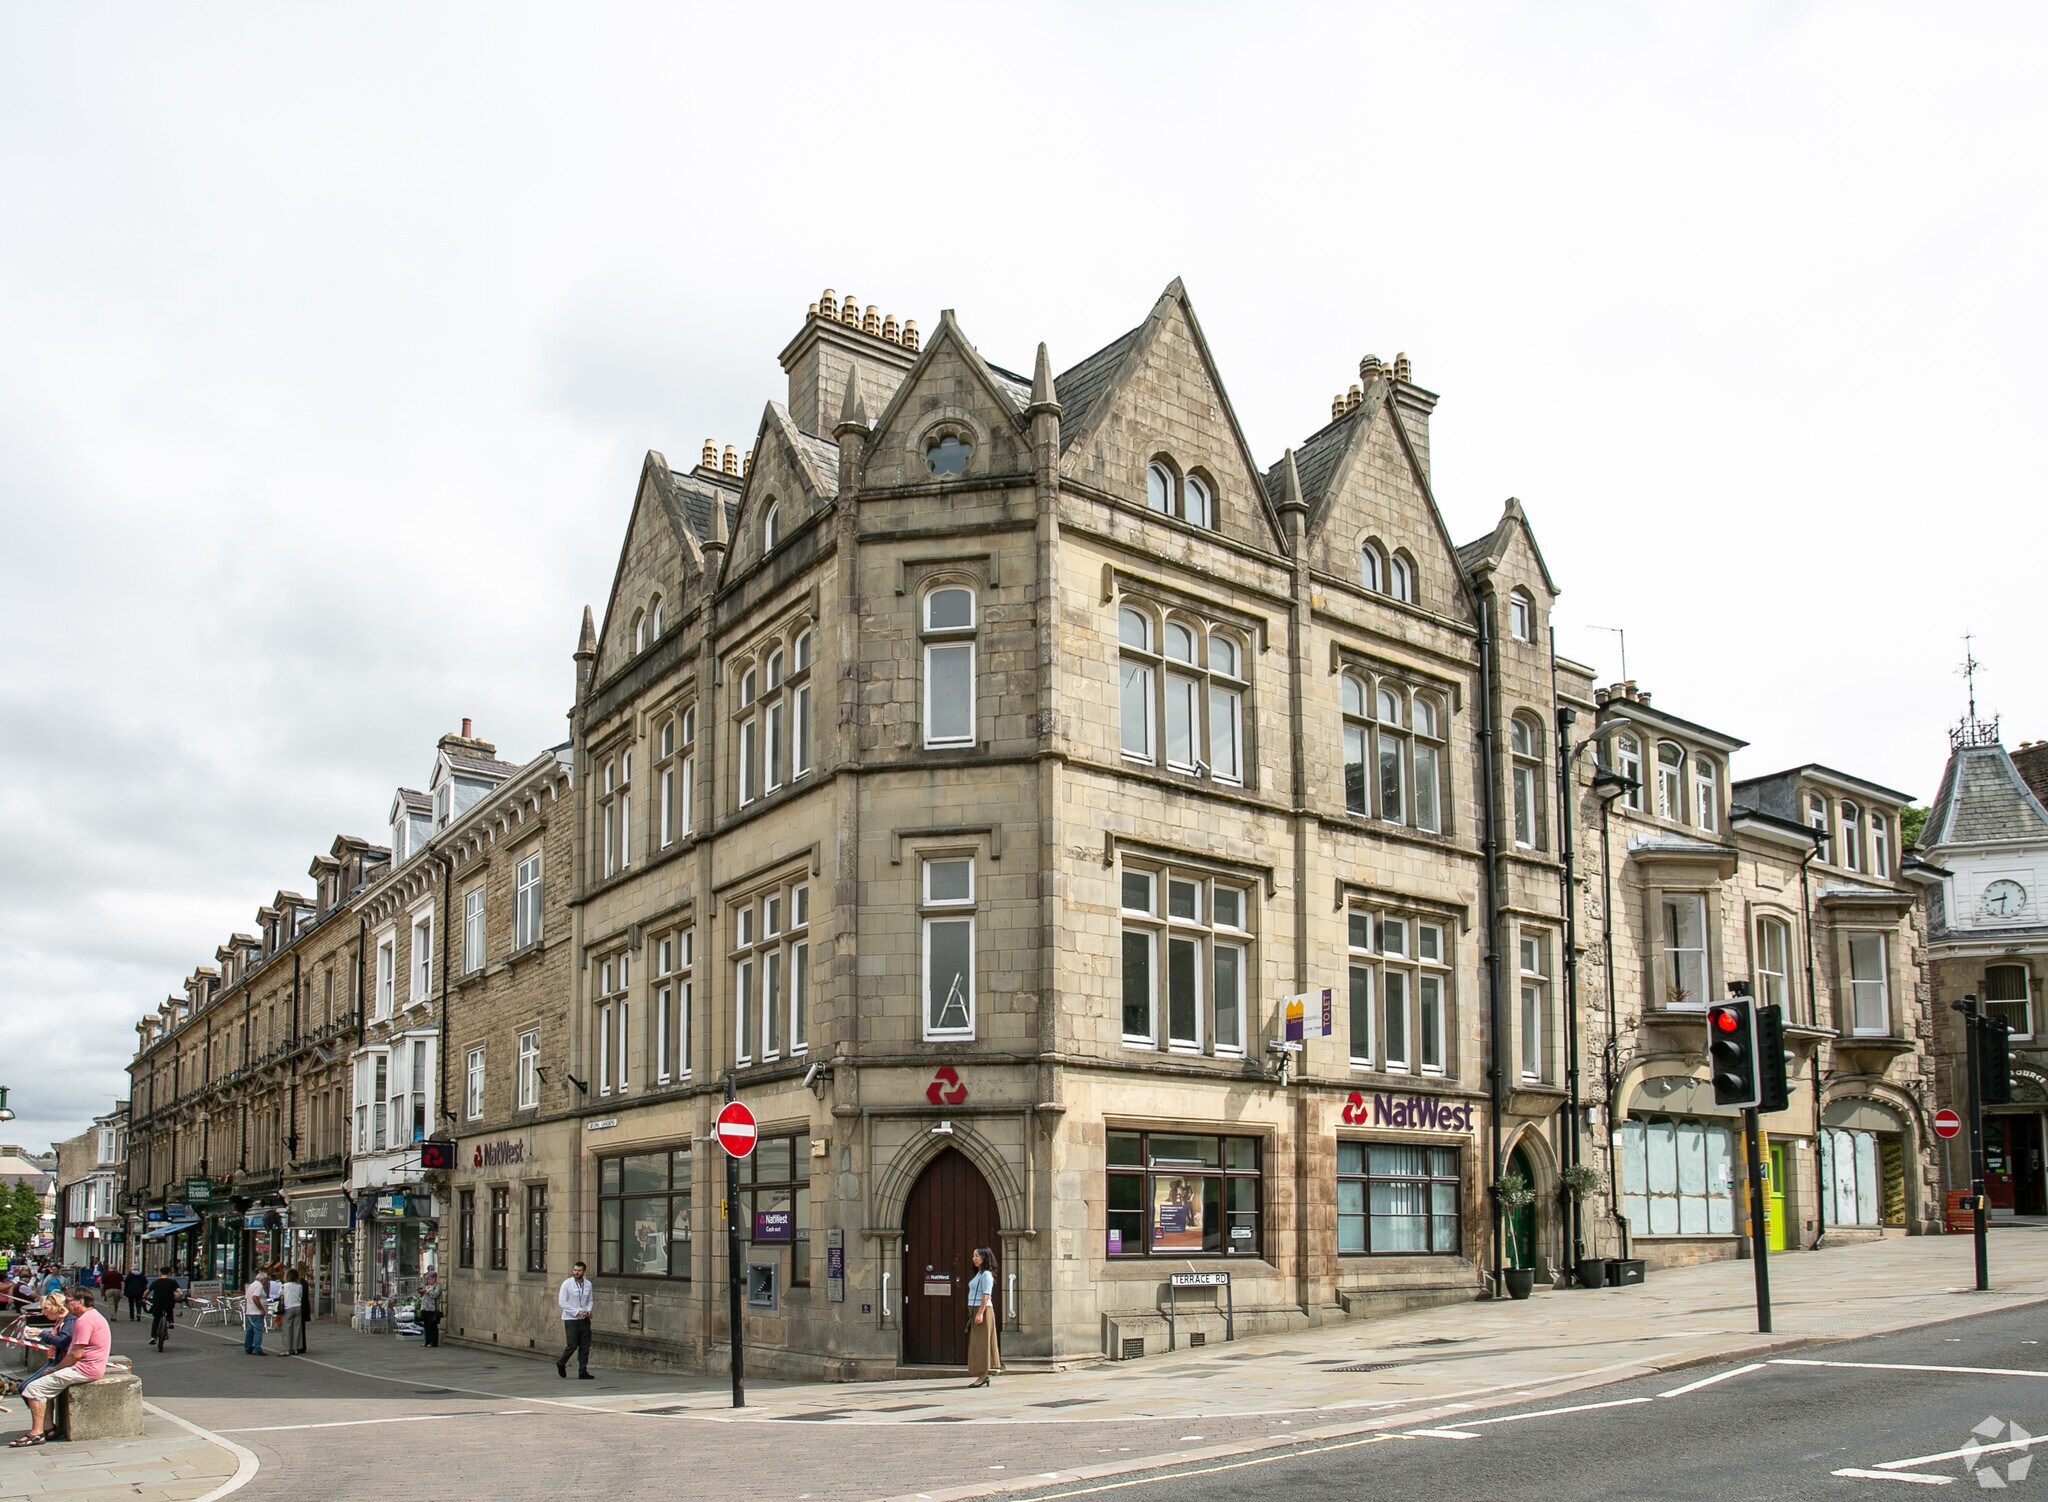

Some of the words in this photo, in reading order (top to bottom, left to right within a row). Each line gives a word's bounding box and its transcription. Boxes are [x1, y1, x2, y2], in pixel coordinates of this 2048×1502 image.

[1323, 1013, 1330, 1027] TO
[1374, 1093, 1474, 1131] NatWest
[484, 1138, 523, 1166] NatWest
[766, 1214, 788, 1224] NatWest
[1174, 1274, 1210, 1284] TERRACE
[1215, 1274, 1226, 1283] RD
